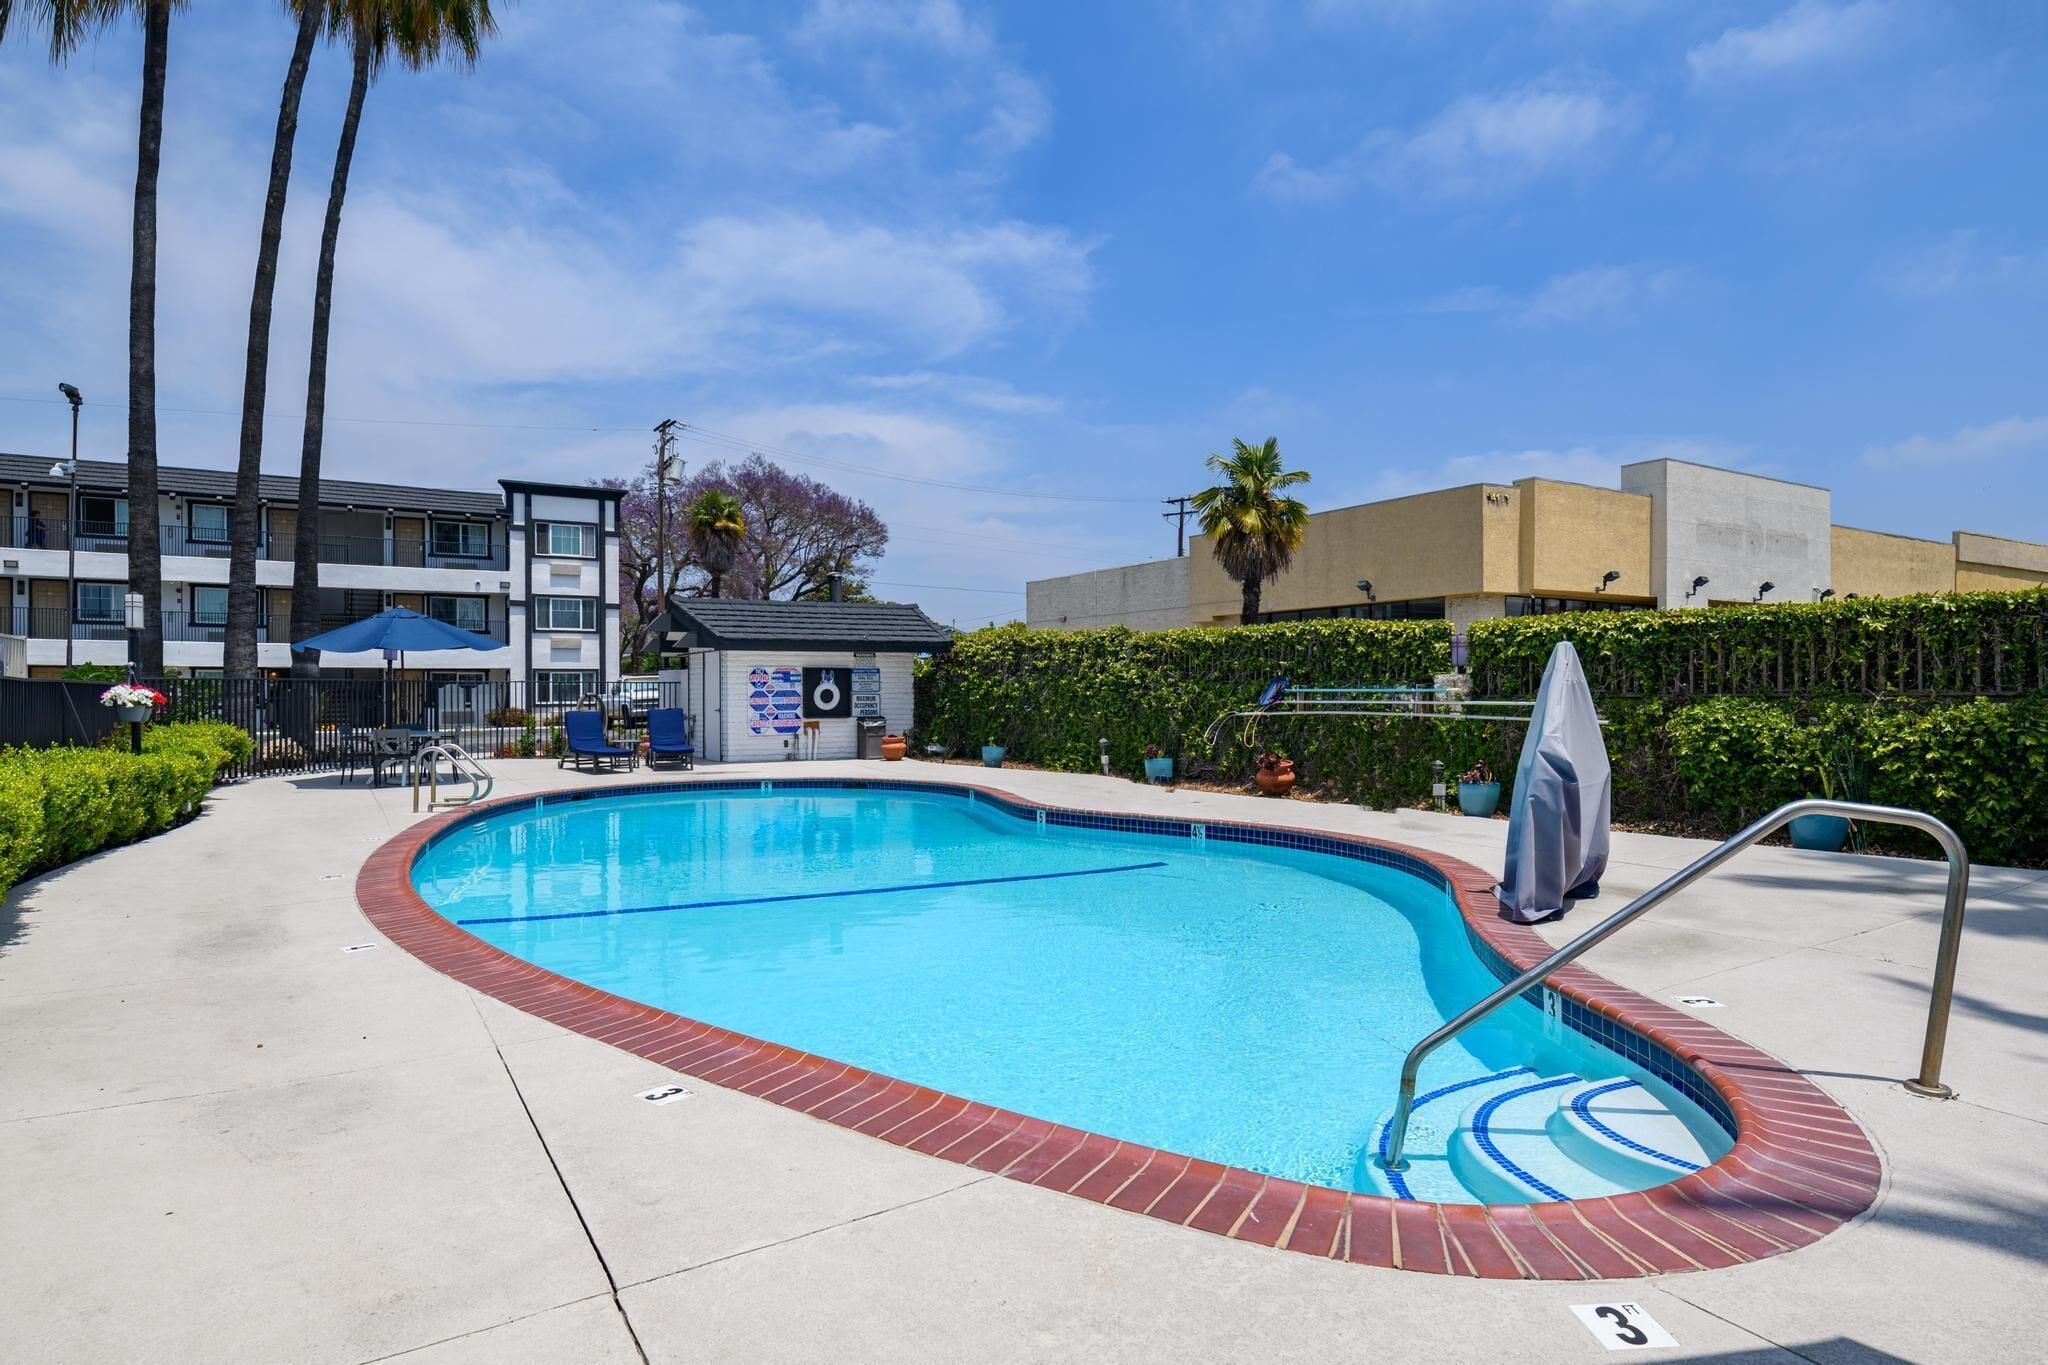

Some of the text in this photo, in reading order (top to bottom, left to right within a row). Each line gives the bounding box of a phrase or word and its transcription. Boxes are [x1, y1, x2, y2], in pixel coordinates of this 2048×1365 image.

[749, 674, 769, 682] DIVING
[1549, 991, 1556, 1017] 3
[645, 1088, 684, 1101] 3
[1621, 1304, 1640, 1315] FT
[1595, 1306, 1648, 1345] 3
